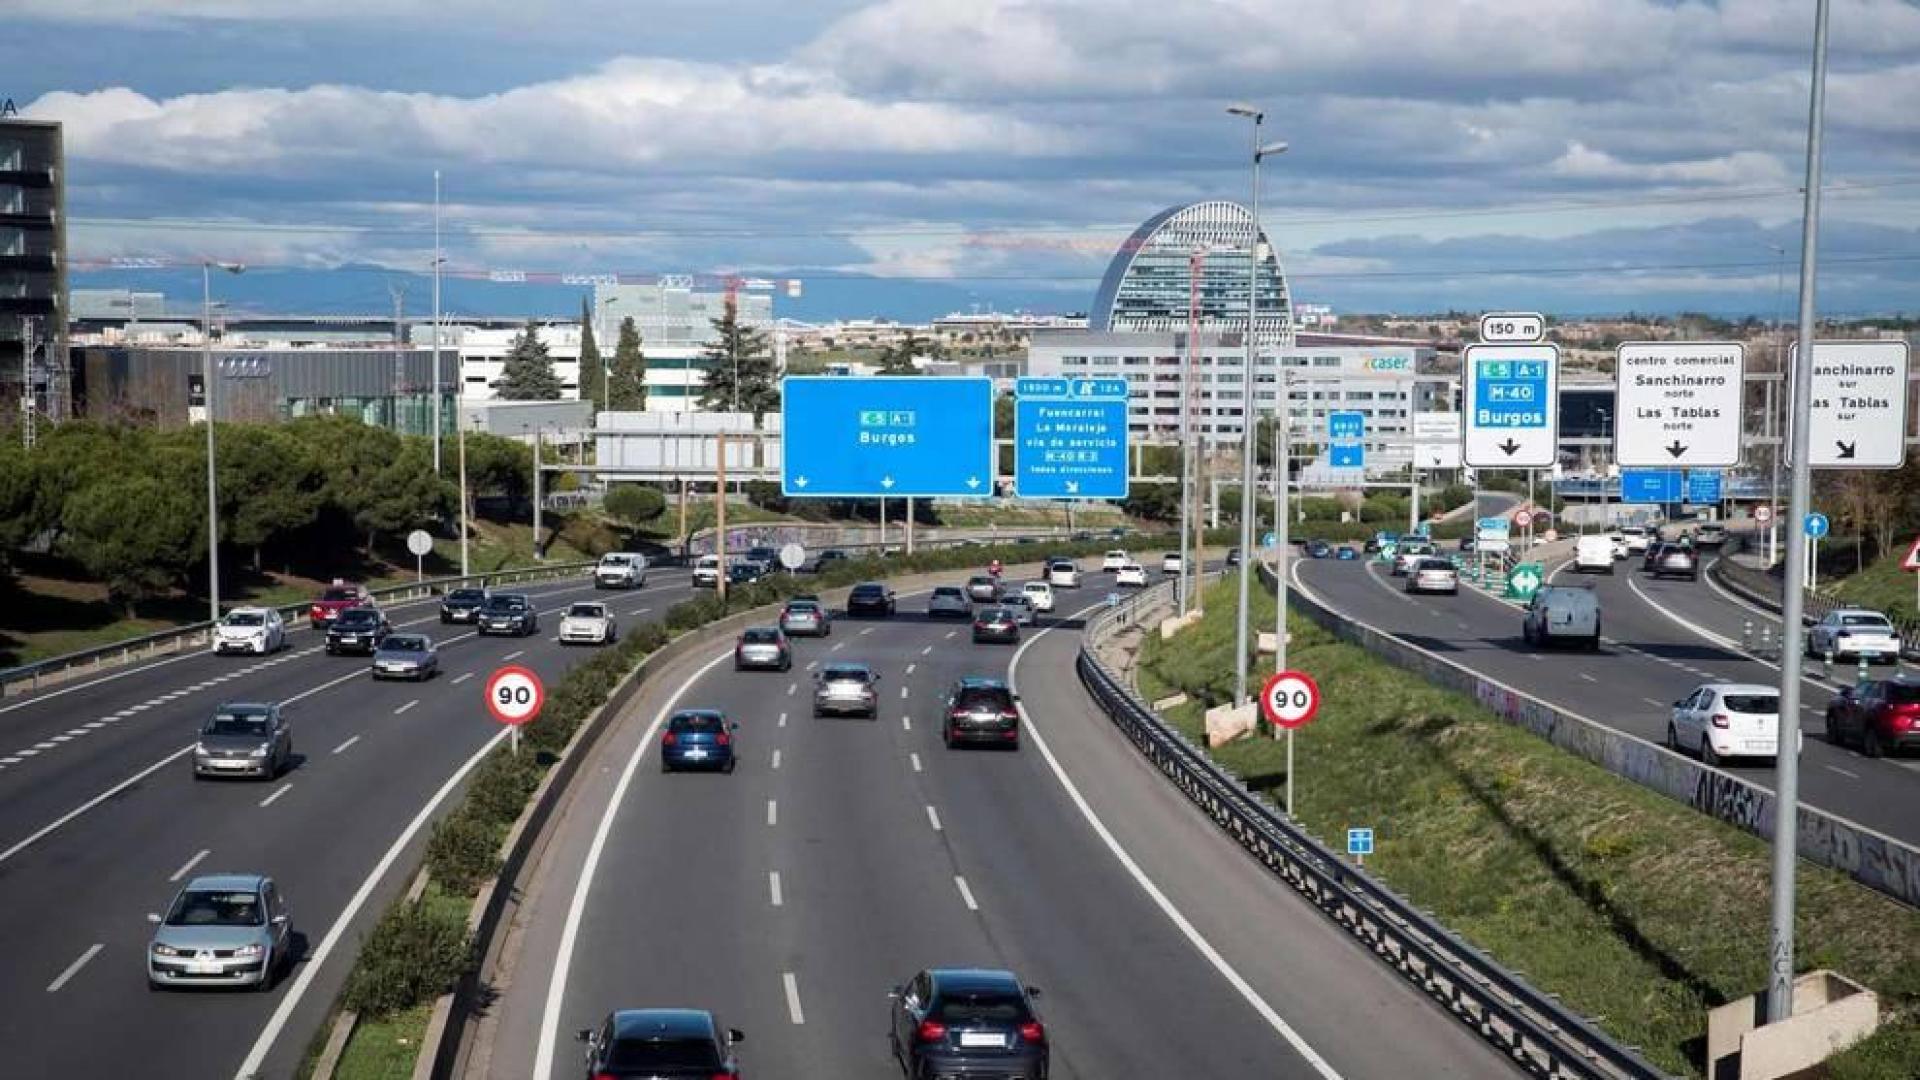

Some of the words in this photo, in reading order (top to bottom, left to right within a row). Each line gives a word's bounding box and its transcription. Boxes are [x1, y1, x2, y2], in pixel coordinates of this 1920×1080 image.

[1489, 323, 1515, 334] 150
[1523, 325, 1536, 334] m
[1370, 358, 1408, 369] caser
[1626, 356, 1667, 366] centro
[1674, 355, 1735, 366] comercial
[1482, 364, 1508, 376] E-5
[1519, 364, 1541, 376] A-1
[1814, 364, 1896, 376] anchinarro
[1636, 374, 1726, 386] Sanchinarro
[1492, 386, 1531, 399] M-40
[1663, 389, 1695, 398] norte
[1811, 399, 1830, 409] as
[1839, 396, 1890, 409] Tablas
[1478, 409, 1543, 426] Burgos
[1636, 406, 1663, 418] Las
[1671, 406, 1721, 418] Tablas
[1663, 422, 1693, 431] norte
[860, 431, 915, 447] Burgos
[498, 685, 531, 705] 90
[1275, 689, 1308, 709] 90
